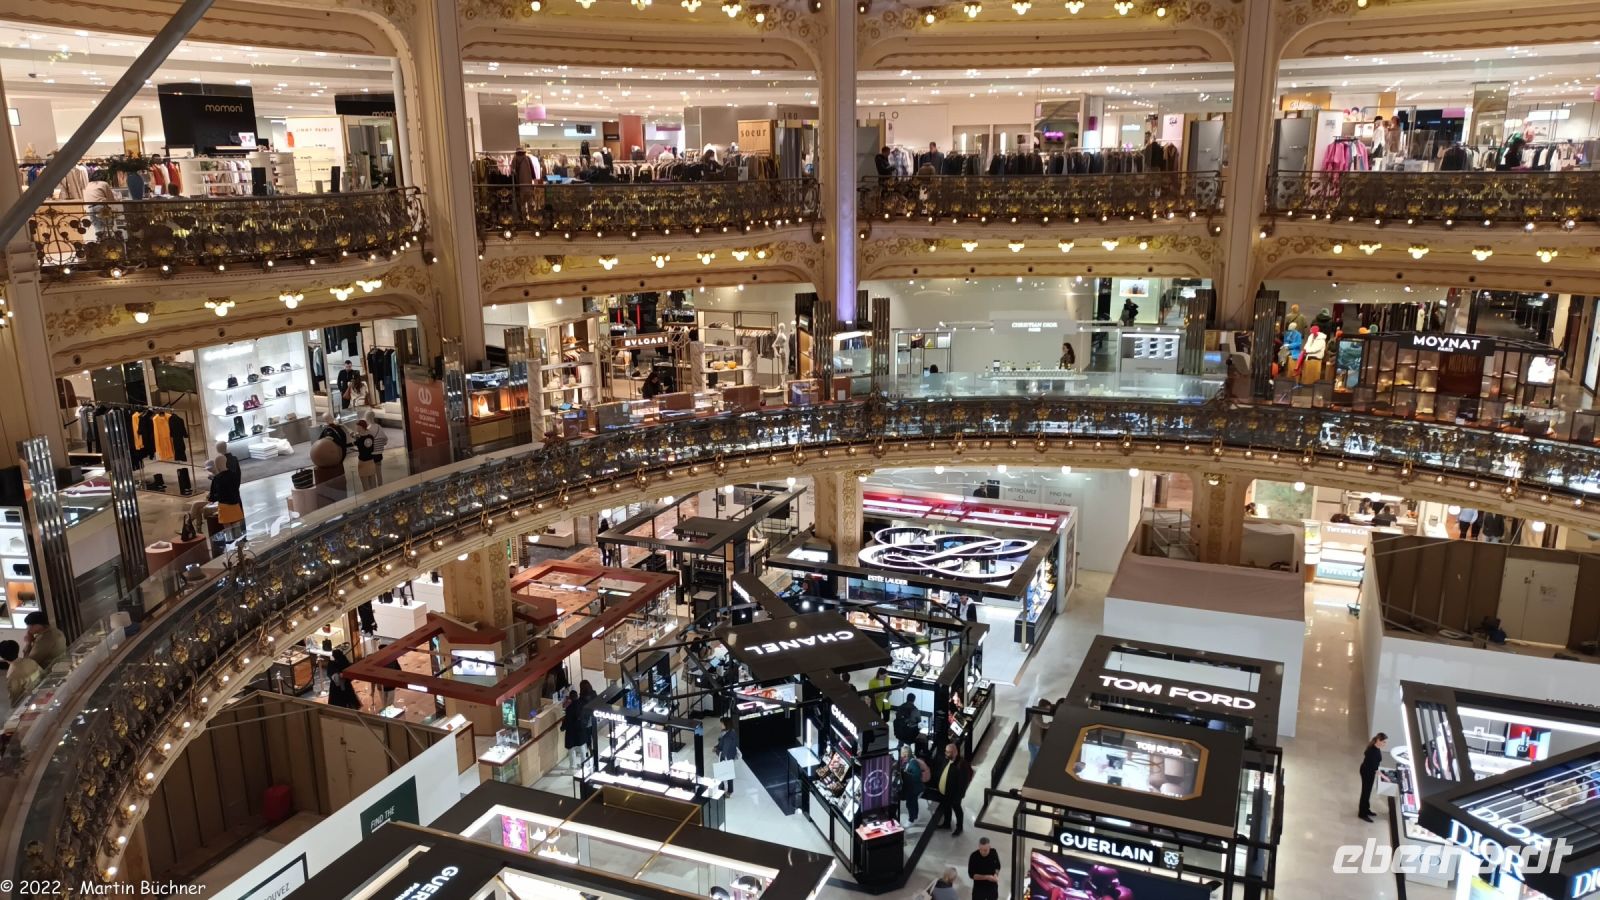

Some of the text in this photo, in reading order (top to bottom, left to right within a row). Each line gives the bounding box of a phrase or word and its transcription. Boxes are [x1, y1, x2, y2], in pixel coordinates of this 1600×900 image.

[205, 104, 243, 113] momoni
[740, 128, 767, 138] soeur
[625, 336, 668, 347] BVLGARI
[1413, 335, 1481, 351] MOYNAT
[744, 630, 854, 655] CHANEL
[1099, 675, 1256, 710] TOM FORD
[593, 709, 628, 723] CHANEL
[1136, 741, 1156, 754] TOM
[370, 805, 395, 830] FIND THE
[1467, 806, 1553, 850] DIOR
[1060, 832, 1154, 863] GUERLAIN
[1450, 818, 1526, 881] DIOR
